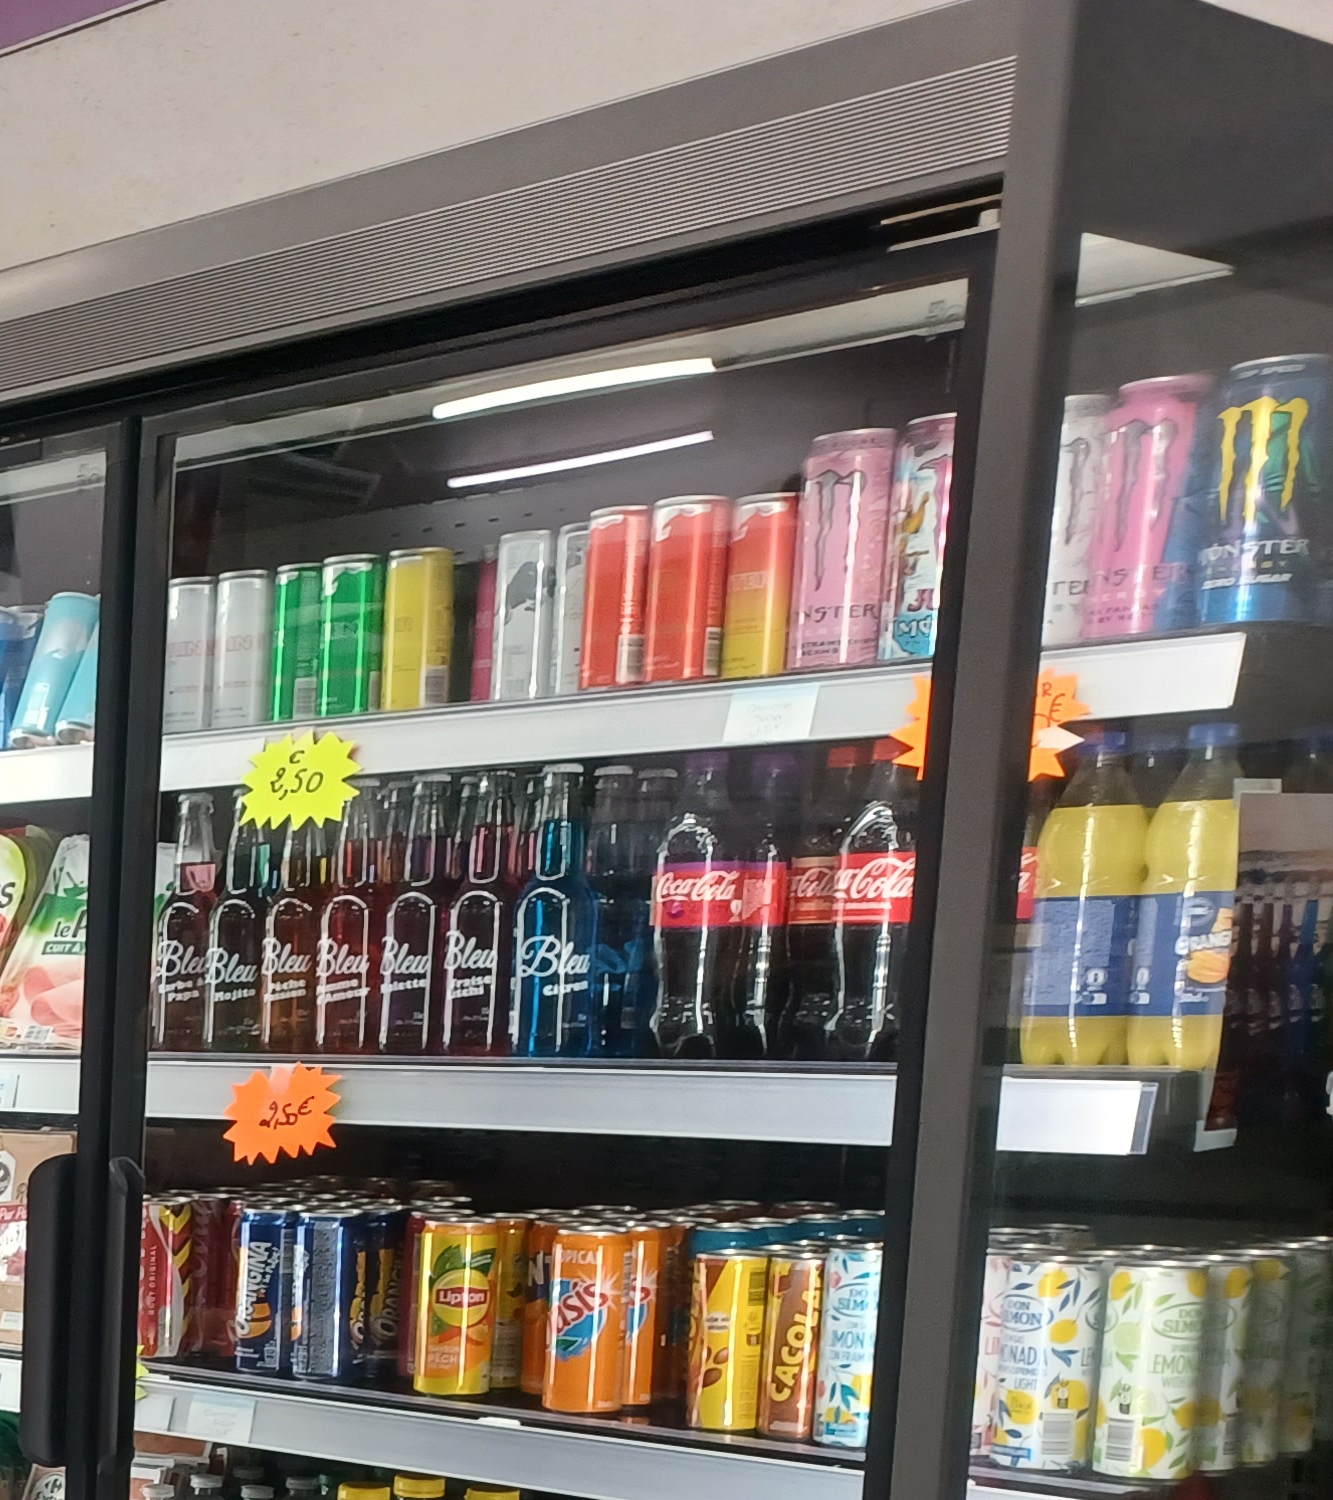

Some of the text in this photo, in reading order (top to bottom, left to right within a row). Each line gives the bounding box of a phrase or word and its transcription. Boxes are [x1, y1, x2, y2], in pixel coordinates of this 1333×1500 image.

[270, 767, 324, 800] 2,50
[656, 869, 740, 903] Coca-Cola
[45, 943, 70, 954] CUIT
[156, 938, 206, 978] Bleu
[205, 946, 258, 985] Bleu
[262, 937, 312, 977] Bleu
[317, 937, 370, 977] Bleu
[380, 935, 431, 975] Bleu
[444, 930, 497, 970] Bleu
[520, 935, 590, 978] Bleu
[214, 987, 256, 1002] Mojito
[438, 1290, 485, 1305] Lipton
